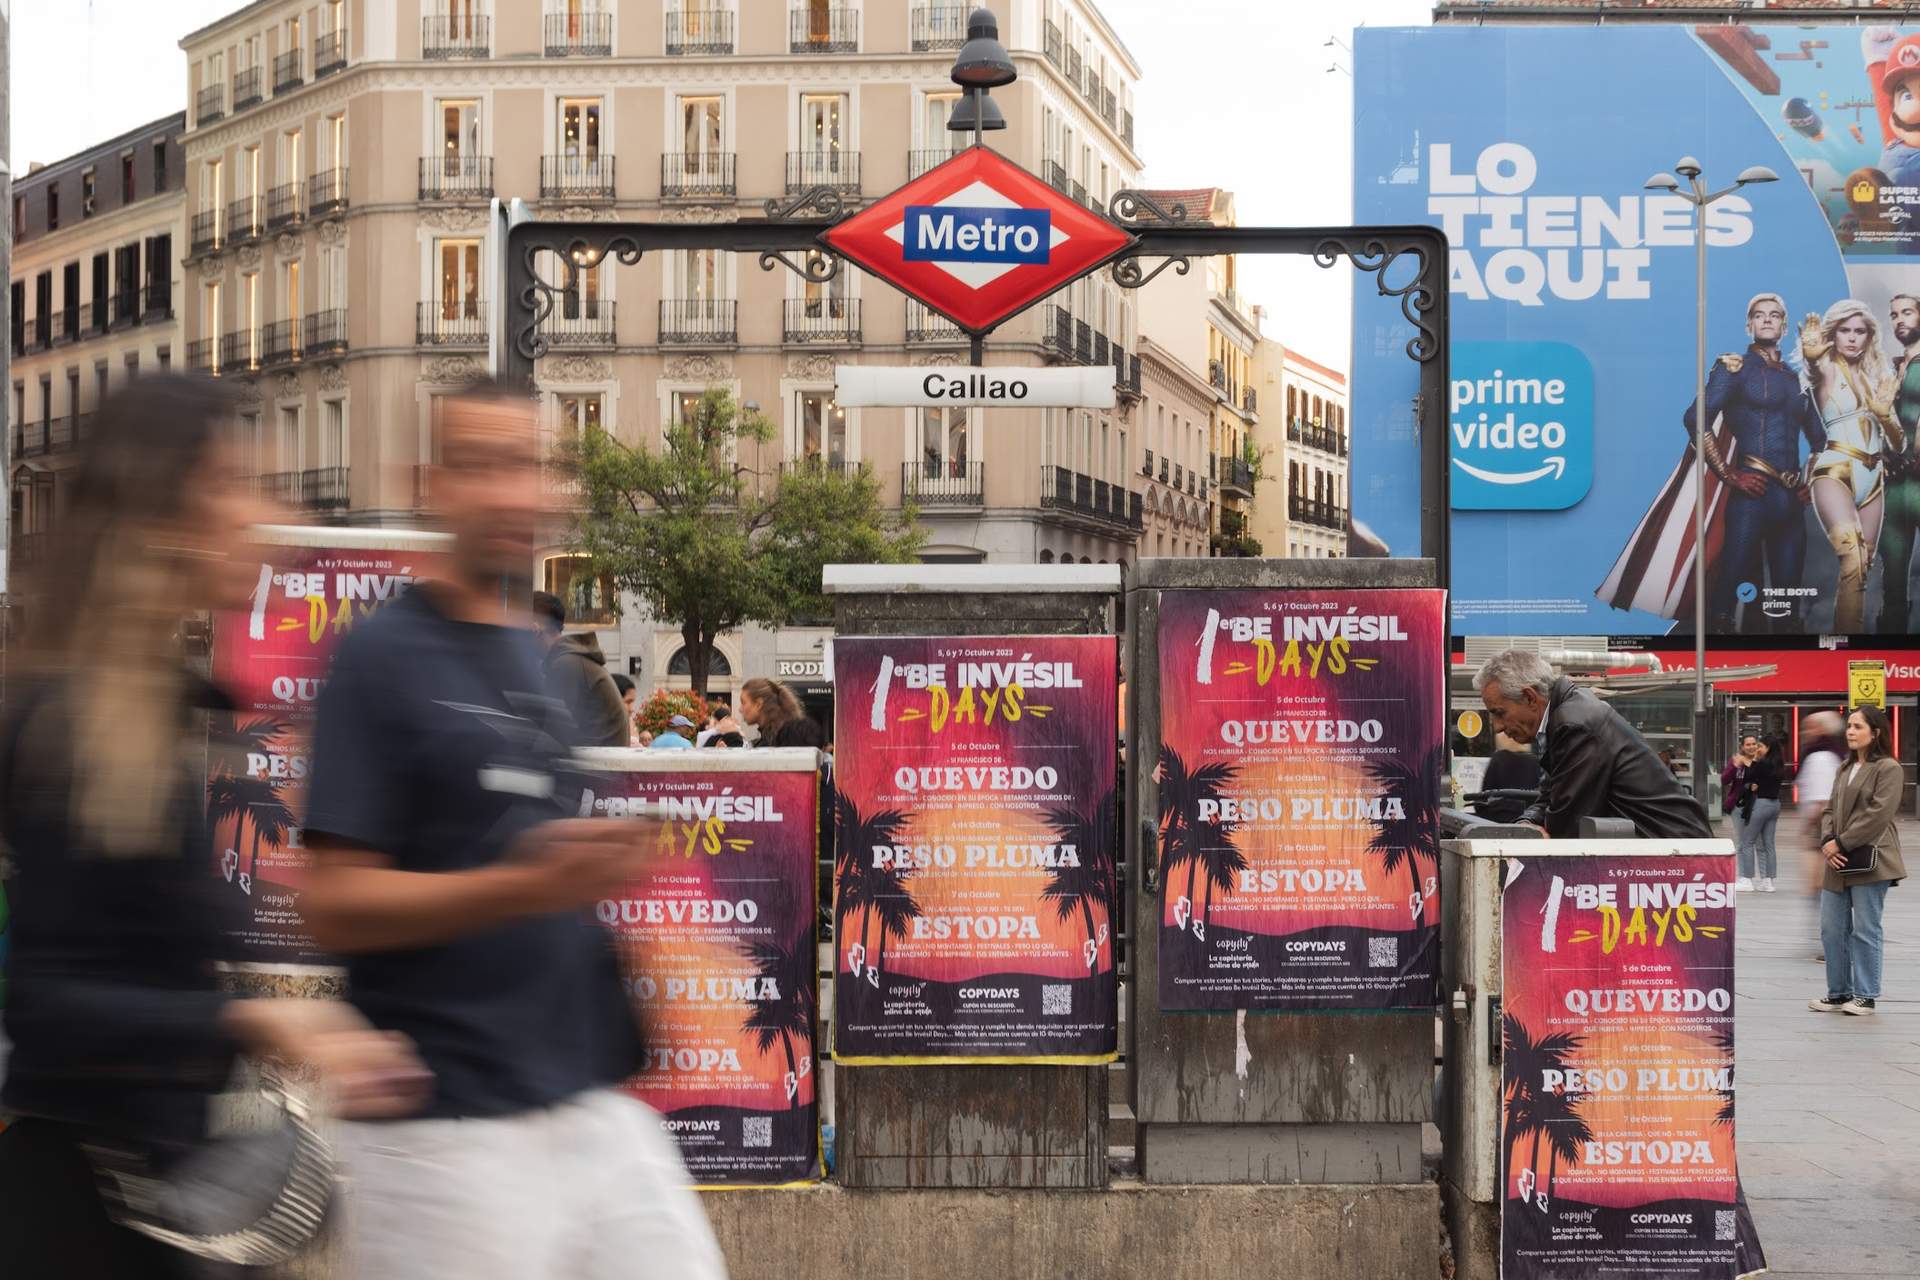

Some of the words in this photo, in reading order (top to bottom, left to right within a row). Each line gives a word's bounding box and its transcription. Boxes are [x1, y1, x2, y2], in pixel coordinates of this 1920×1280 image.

[1429, 142, 1536, 194] LO
[1880, 187, 1918, 195] SUPER
[1428, 194, 1754, 247] TIENES
[918, 214, 1039, 253] Metro
[923, 374, 1028, 399] Callao
[1451, 369, 1565, 414] prime
[1452, 413, 1566, 449] video
[343, 560, 373, 568] Octubre
[375, 561, 392, 569] 2023
[285, 573, 325, 598] BE
[1762, 588, 1785, 596] THE
[1787, 588, 1818, 596] BOYS
[1290, 602, 1319, 610] Octubre
[1321, 602, 1338, 610] 2023
[1762, 600, 1791, 610] prime
[1232, 617, 1272, 642] BE
[1284, 607, 1408, 641] INVÉSIL
[964, 649, 994, 657] Octubre
[1251, 636, 1350, 686] DAYS
[907, 664, 946, 688] BE
[958, 653, 1082, 688] INVÉSIL
[927, 684, 1024, 733] DAYS
[1221, 720, 1383, 747] QUEVEDO
[247, 753, 308, 778] PES
[665, 783, 695, 791] Octubre
[697, 783, 714, 791] 2023
[895, 766, 1058, 793] QUEVEDO
[659, 787, 782, 822] INVÉSIL
[1198, 798, 1282, 822] PESO
[1292, 797, 1406, 820] PLUMA
[656, 816, 726, 858] AYS
[872, 845, 956, 868] PESO
[965, 845, 1081, 867] PLUMA
[669, 876, 700, 884] Octubre
[1240, 869, 1367, 893] ESTOPA
[1577, 884, 1617, 909] BE
[596, 899, 758, 926] QUEVEDO
[912, 916, 1040, 939] ESTOPA
[1597, 903, 1696, 955] DAYS
[1216, 938, 1248, 951] copyfly
[1286, 941, 1346, 951] COPYDAYS
[665, 977, 781, 1000] PLUMA
[889, 984, 921, 998] copyfly
[959, 988, 1020, 999] COPYDAYS
[1565, 988, 1731, 1016] QUEVEDO
[1641, 1044, 1672, 1052] Octubre
[1542, 1069, 1628, 1092] PESO
[660, 1121, 720, 1131] COPYDAYS
[1584, 1140, 1714, 1164] ESTOPA
[1560, 1211, 1592, 1223] copyfly
[1631, 1214, 1692, 1224] COPYDAYS
